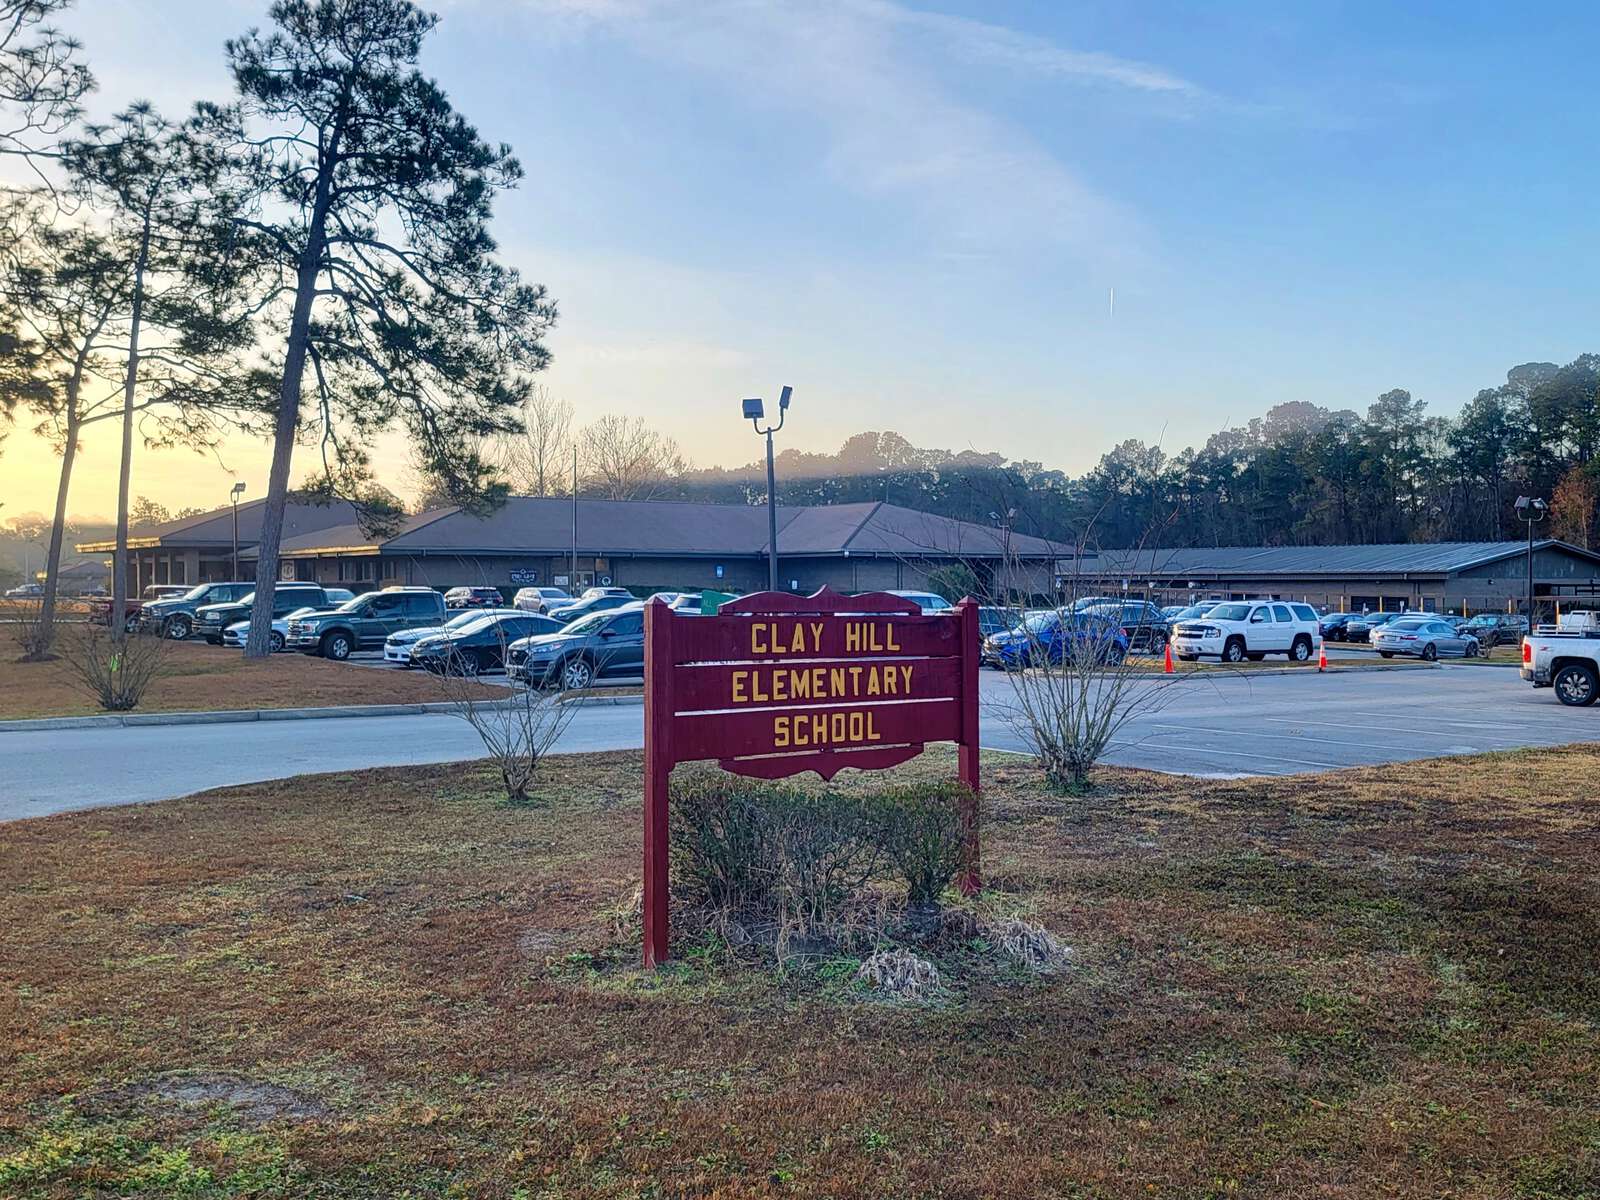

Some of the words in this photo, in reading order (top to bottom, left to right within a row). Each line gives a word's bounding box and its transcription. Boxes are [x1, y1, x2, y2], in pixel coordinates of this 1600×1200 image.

[751, 622, 824, 654] CLAY
[846, 622, 901, 651] HILL
[732, 666, 914, 702] ELEMENTARY
[774, 712, 881, 747] SCHOOL
